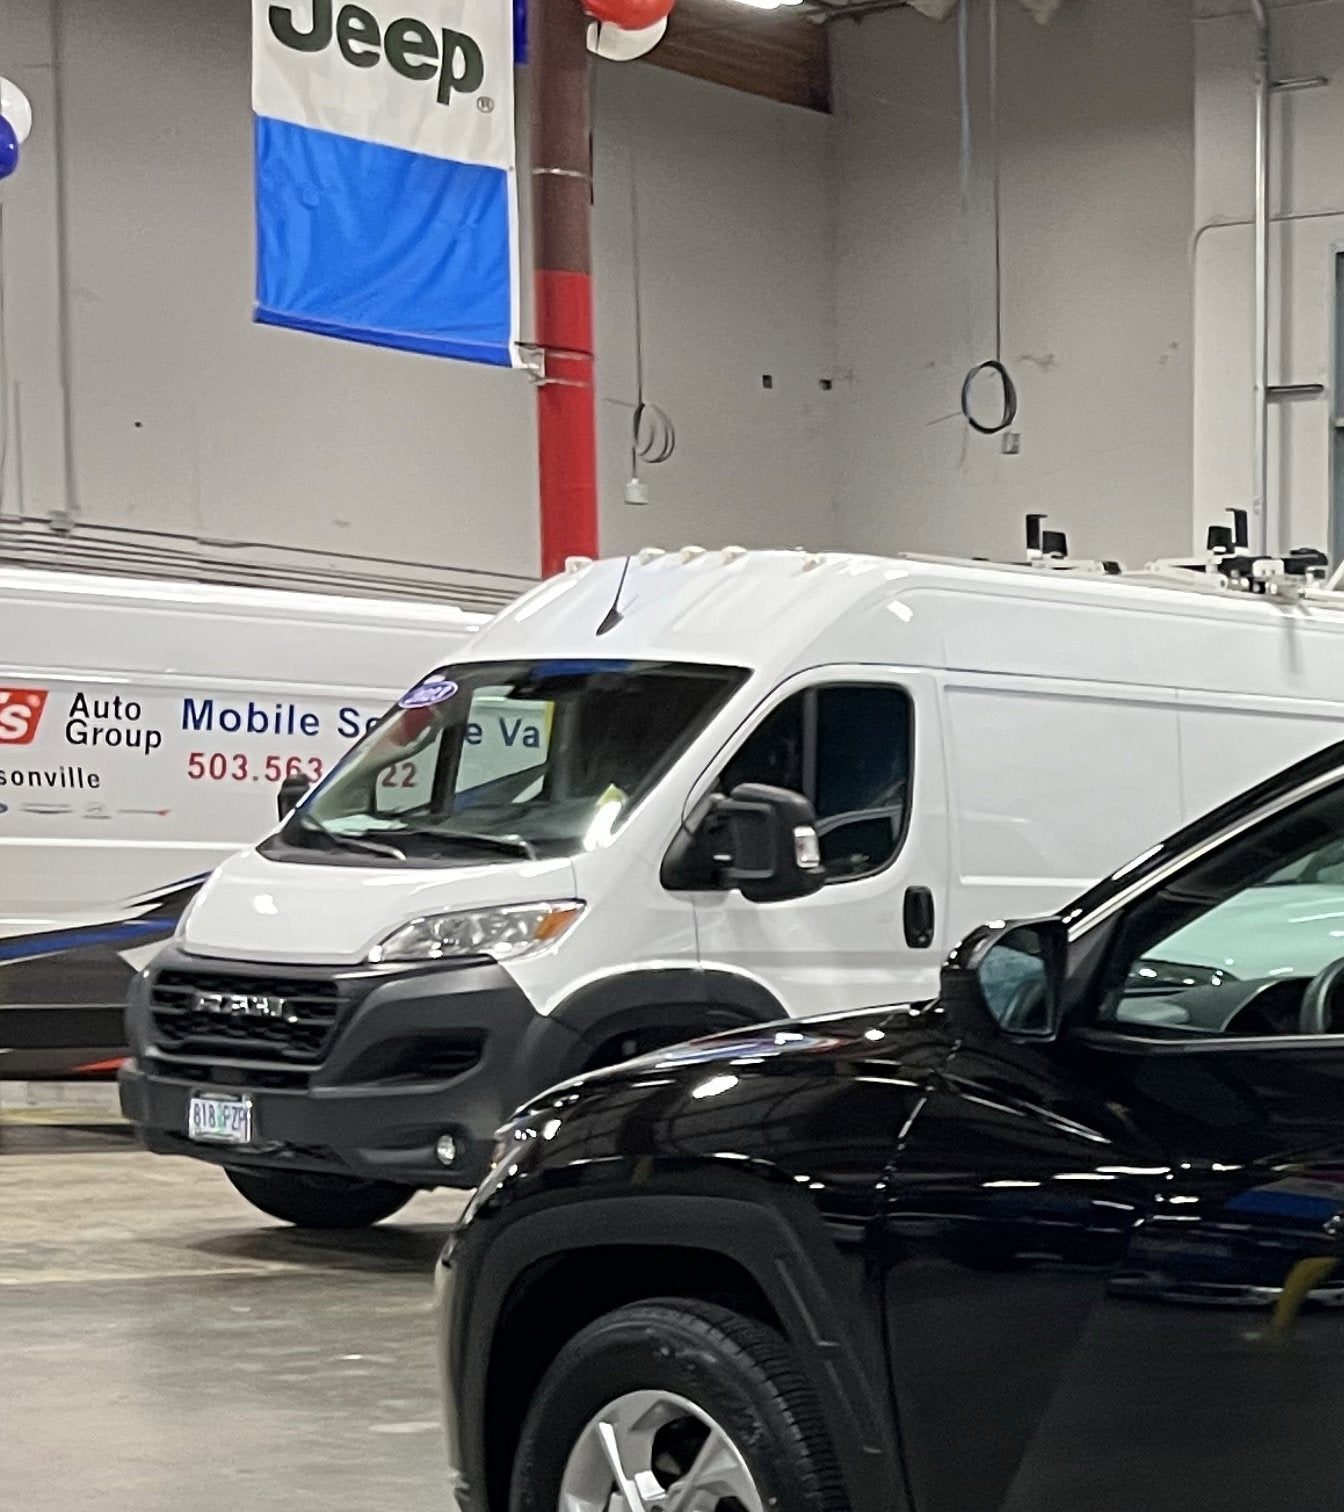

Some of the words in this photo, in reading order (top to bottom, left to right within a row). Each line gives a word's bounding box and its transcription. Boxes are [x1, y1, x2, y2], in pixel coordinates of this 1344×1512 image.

[268, 0, 484, 106] Jeep
[69, 692, 142, 721] Auto
[181, 698, 320, 737] Mobile
[65, 718, 163, 755] Group
